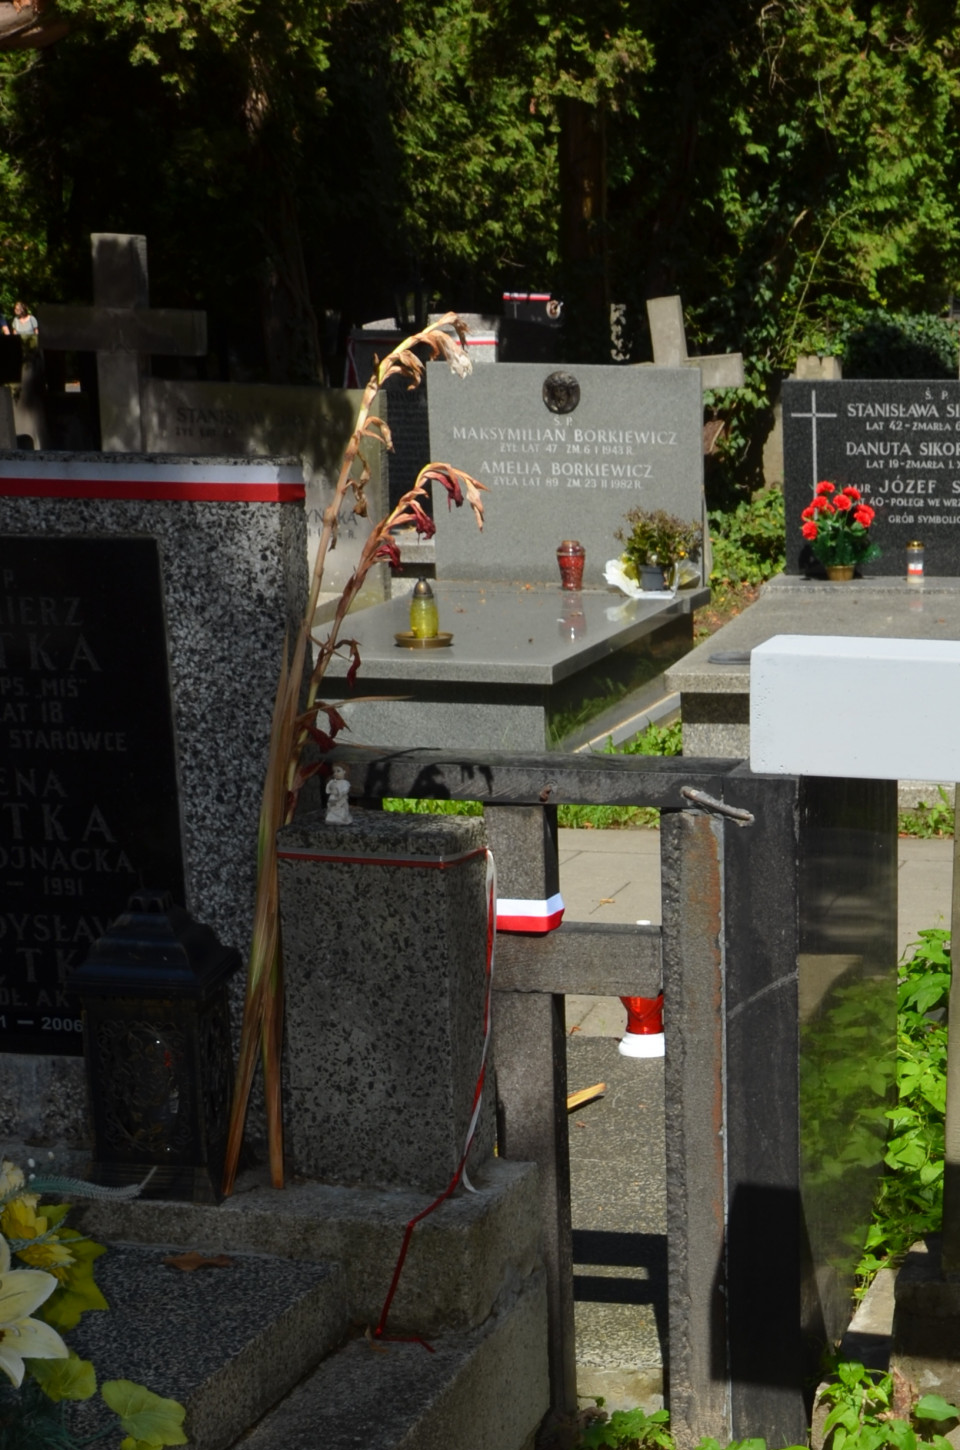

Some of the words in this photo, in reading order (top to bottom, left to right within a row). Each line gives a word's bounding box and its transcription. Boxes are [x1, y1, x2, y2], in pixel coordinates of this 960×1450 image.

[847, 403, 939, 418] STANISŁAWA
[866, 420, 884, 431] LAT
[453, 426, 566, 442] MAKSYMILIAN
[574, 429, 678, 446] BORKIEWICZ
[521, 444, 540, 453] LAT
[545, 444, 557, 453] 47
[846, 441, 912, 456] DANUTA
[480, 461, 542, 476] AMELIA
[551, 462, 653, 479] BORKIEWICZ
[866, 459, 884, 469] LAT
[522, 477, 540, 487] LAT
[879, 475, 937, 494] JÓZEF
[927, 498, 940, 507] WE
[888, 512, 914, 524] GRÓB
[0, 595, 84, 626] IERZ
[0, 702, 28, 723] AT
[41, 701, 64, 724] 18
[9, 726, 128, 752] STARÓWCE
[43, 875, 84, 897] 1991
[36, 988, 70, 1008] AK
[41, 1016, 83, 1033] 2006
